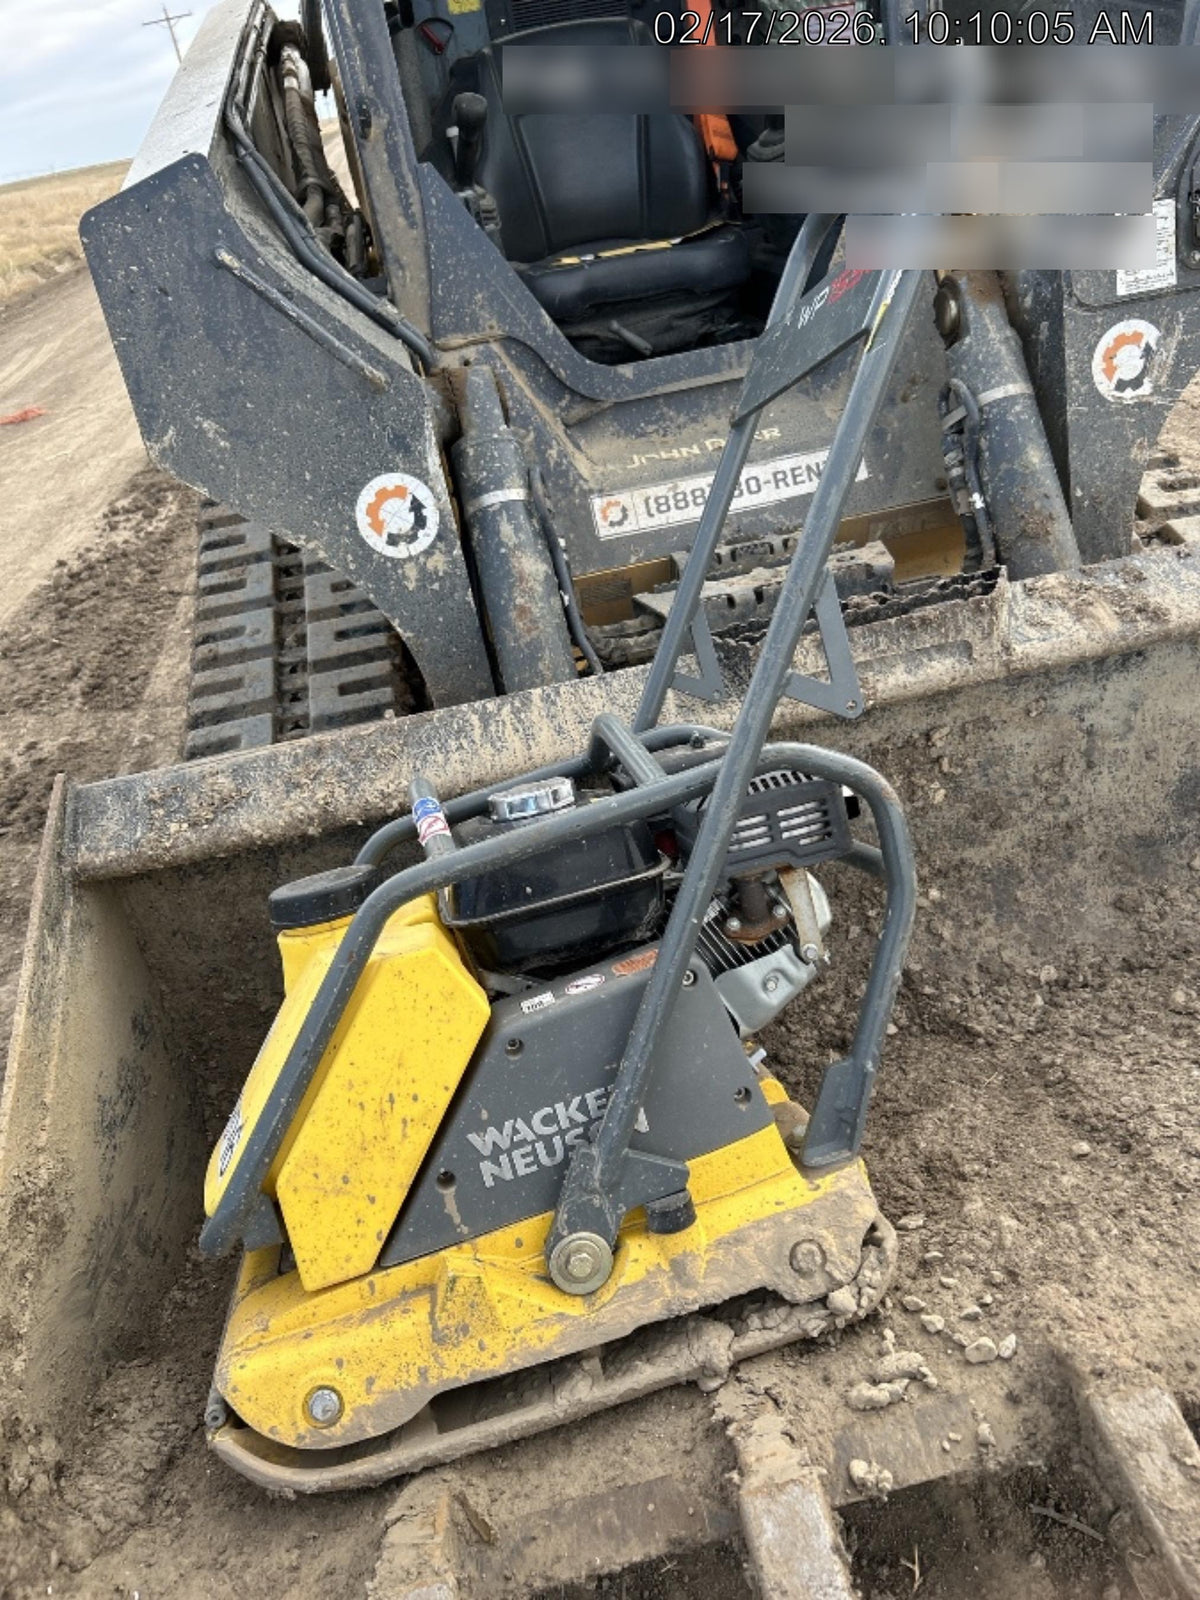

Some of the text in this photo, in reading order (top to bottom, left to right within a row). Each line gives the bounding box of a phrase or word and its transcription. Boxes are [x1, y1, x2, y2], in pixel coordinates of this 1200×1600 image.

[643, 482, 713, 518] (888
[466, 1084, 615, 1157] WACKE
[479, 1107, 650, 1189] NEUS
